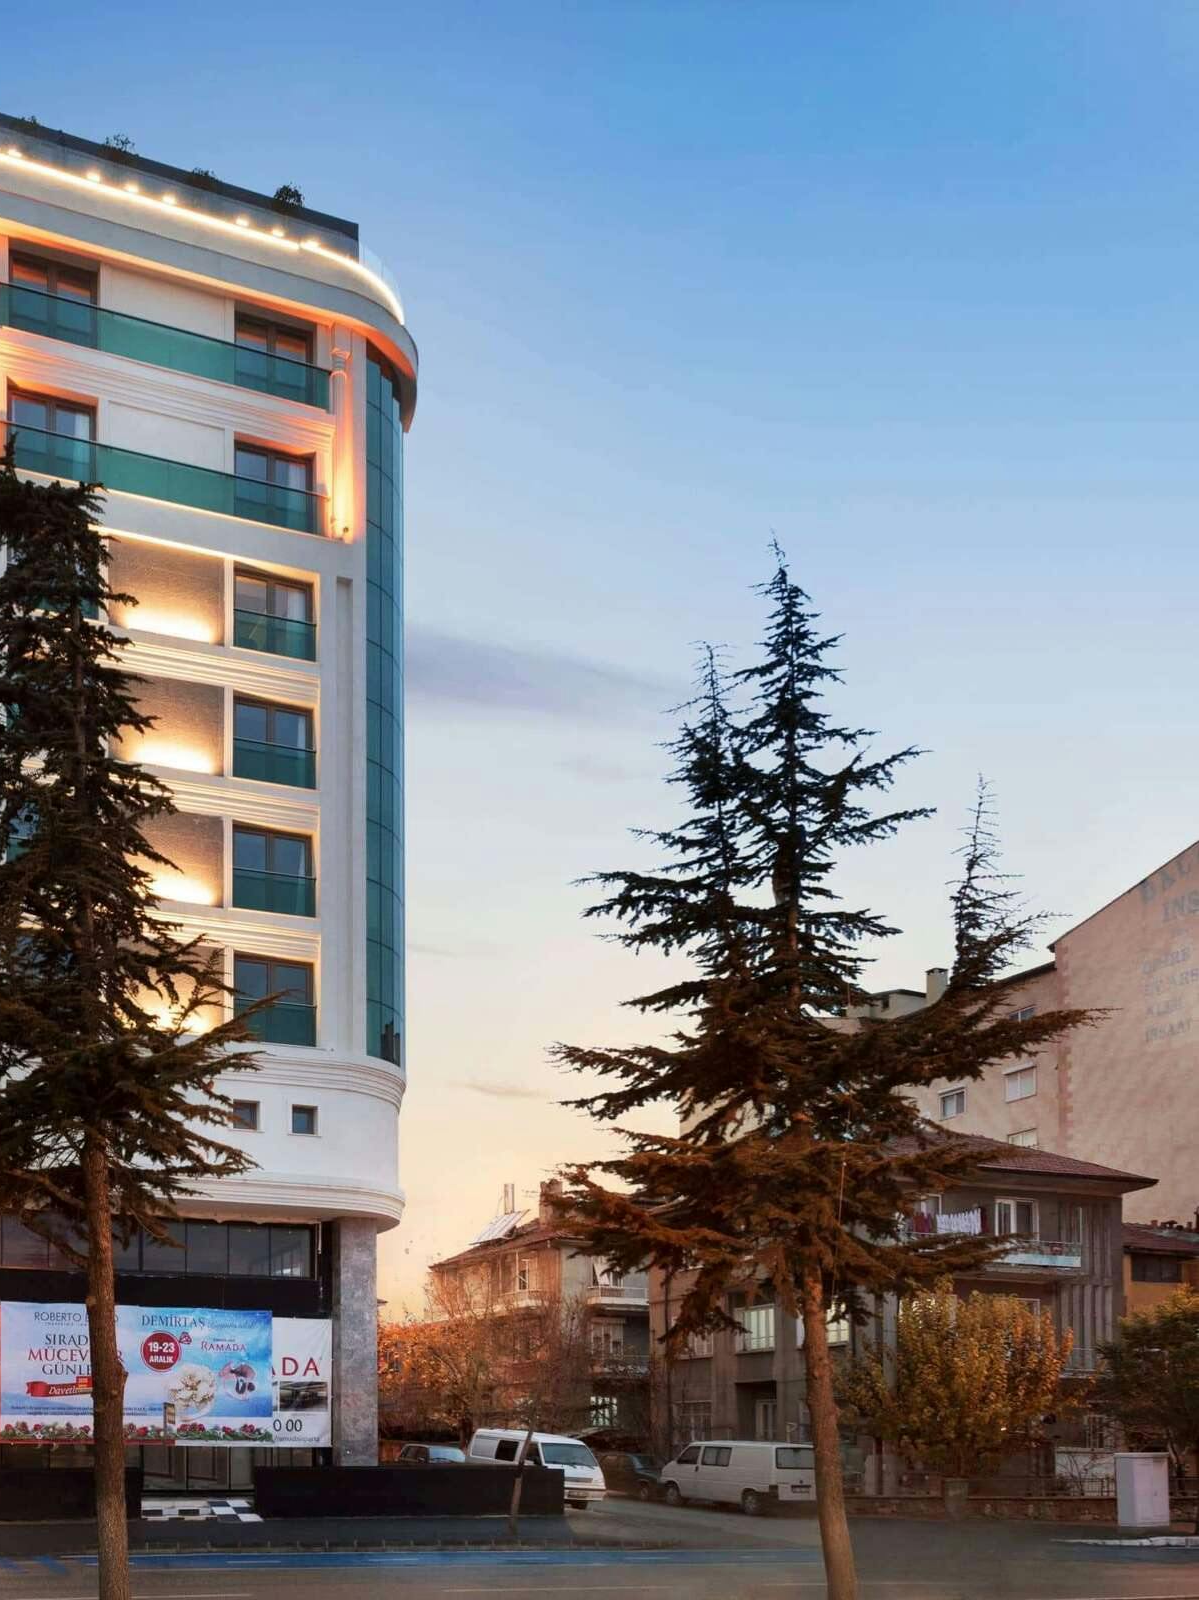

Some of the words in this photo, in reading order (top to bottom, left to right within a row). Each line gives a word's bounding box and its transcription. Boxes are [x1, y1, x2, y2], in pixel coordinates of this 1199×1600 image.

[34, 1311, 82, 1322] ROBERTO
[44, 1335, 90, 1348] SIRAD
[148, 1341, 175, 1353] 19-23
[201, 1341, 247, 1352] RAMADA
[28, 1346, 125, 1363] MÜCEVR
[149, 1355, 174, 1364] ARALIK
[42, 1361, 91, 1376] GÜNL
